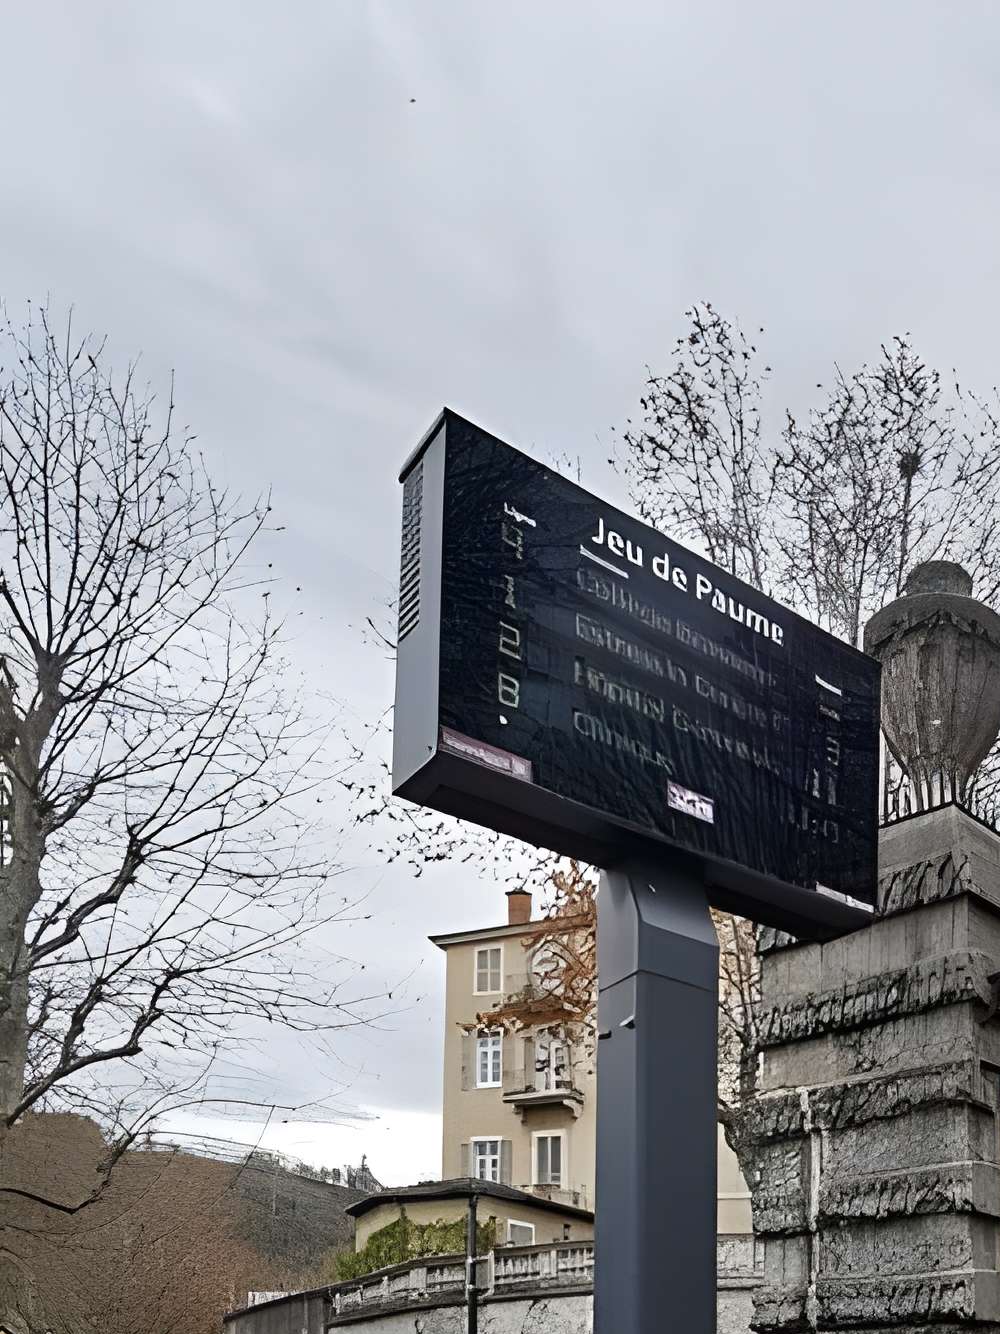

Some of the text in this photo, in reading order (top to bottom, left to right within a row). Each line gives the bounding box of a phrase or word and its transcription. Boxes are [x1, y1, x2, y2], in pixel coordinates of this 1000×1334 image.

[592, 517, 644, 567] Jeu
[652, 552, 688, 593] de
[696, 573, 784, 648] Paume
